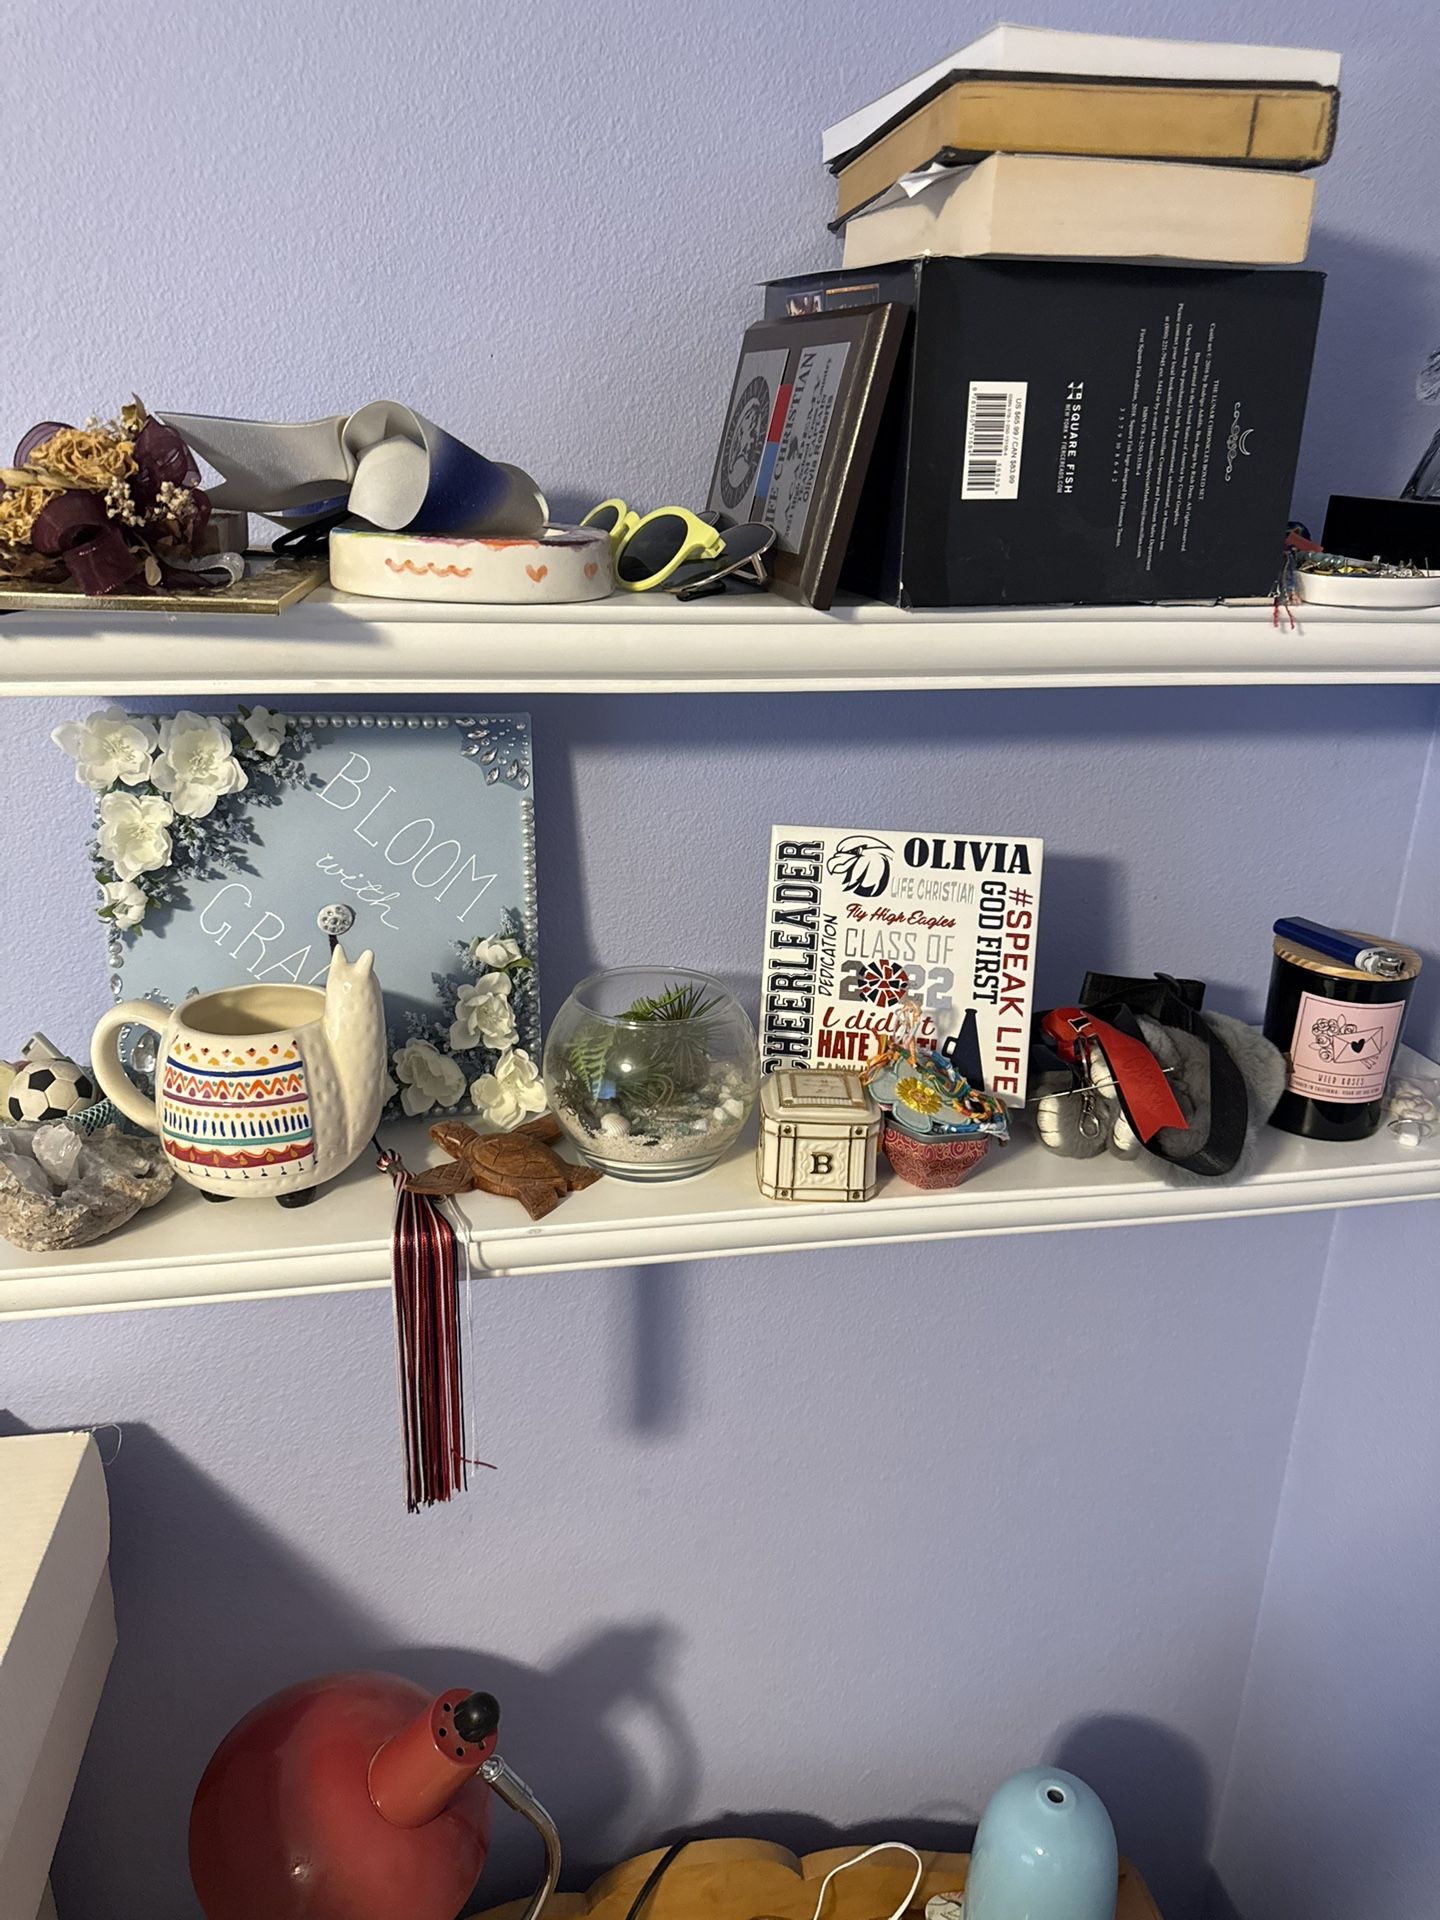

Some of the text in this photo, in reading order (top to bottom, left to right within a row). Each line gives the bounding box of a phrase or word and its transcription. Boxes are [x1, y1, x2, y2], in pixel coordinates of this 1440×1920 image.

[1013, 411, 1021, 435] $65.99
[1015, 398, 1022, 409] US
[1209, 395, 1217, 419] LUNAR
[764, 353, 817, 523] IFE CHRISTIAN
[800, 395, 833, 503] Olivia Roberts
[1064, 404, 1081, 493] SQUARE FISH
[1203, 420, 1214, 463] CHRONICLES
[315, 751, 498, 923] BLOOM
[903, 837, 1032, 875] OLIVIA
[315, 852, 400, 931] with
[890, 876, 975, 904] LIFE CHRISTIAN
[199, 883, 332, 985] GRA
[846, 903, 957, 930] Fly High Eagles
[762, 840, 825, 1075] CHEERLEADER
[817, 913, 839, 997] DEDICATION
[845, 927, 956, 965] CLASS OF
[972, 880, 1007, 1005] GOD FIRST
[992, 886, 1034, 1094] #SPEAK LIFE
[816, 1029, 870, 1062] HATE
[1341, 1077, 1365, 1086] ROSES
[810, 1151, 834, 1175] B
